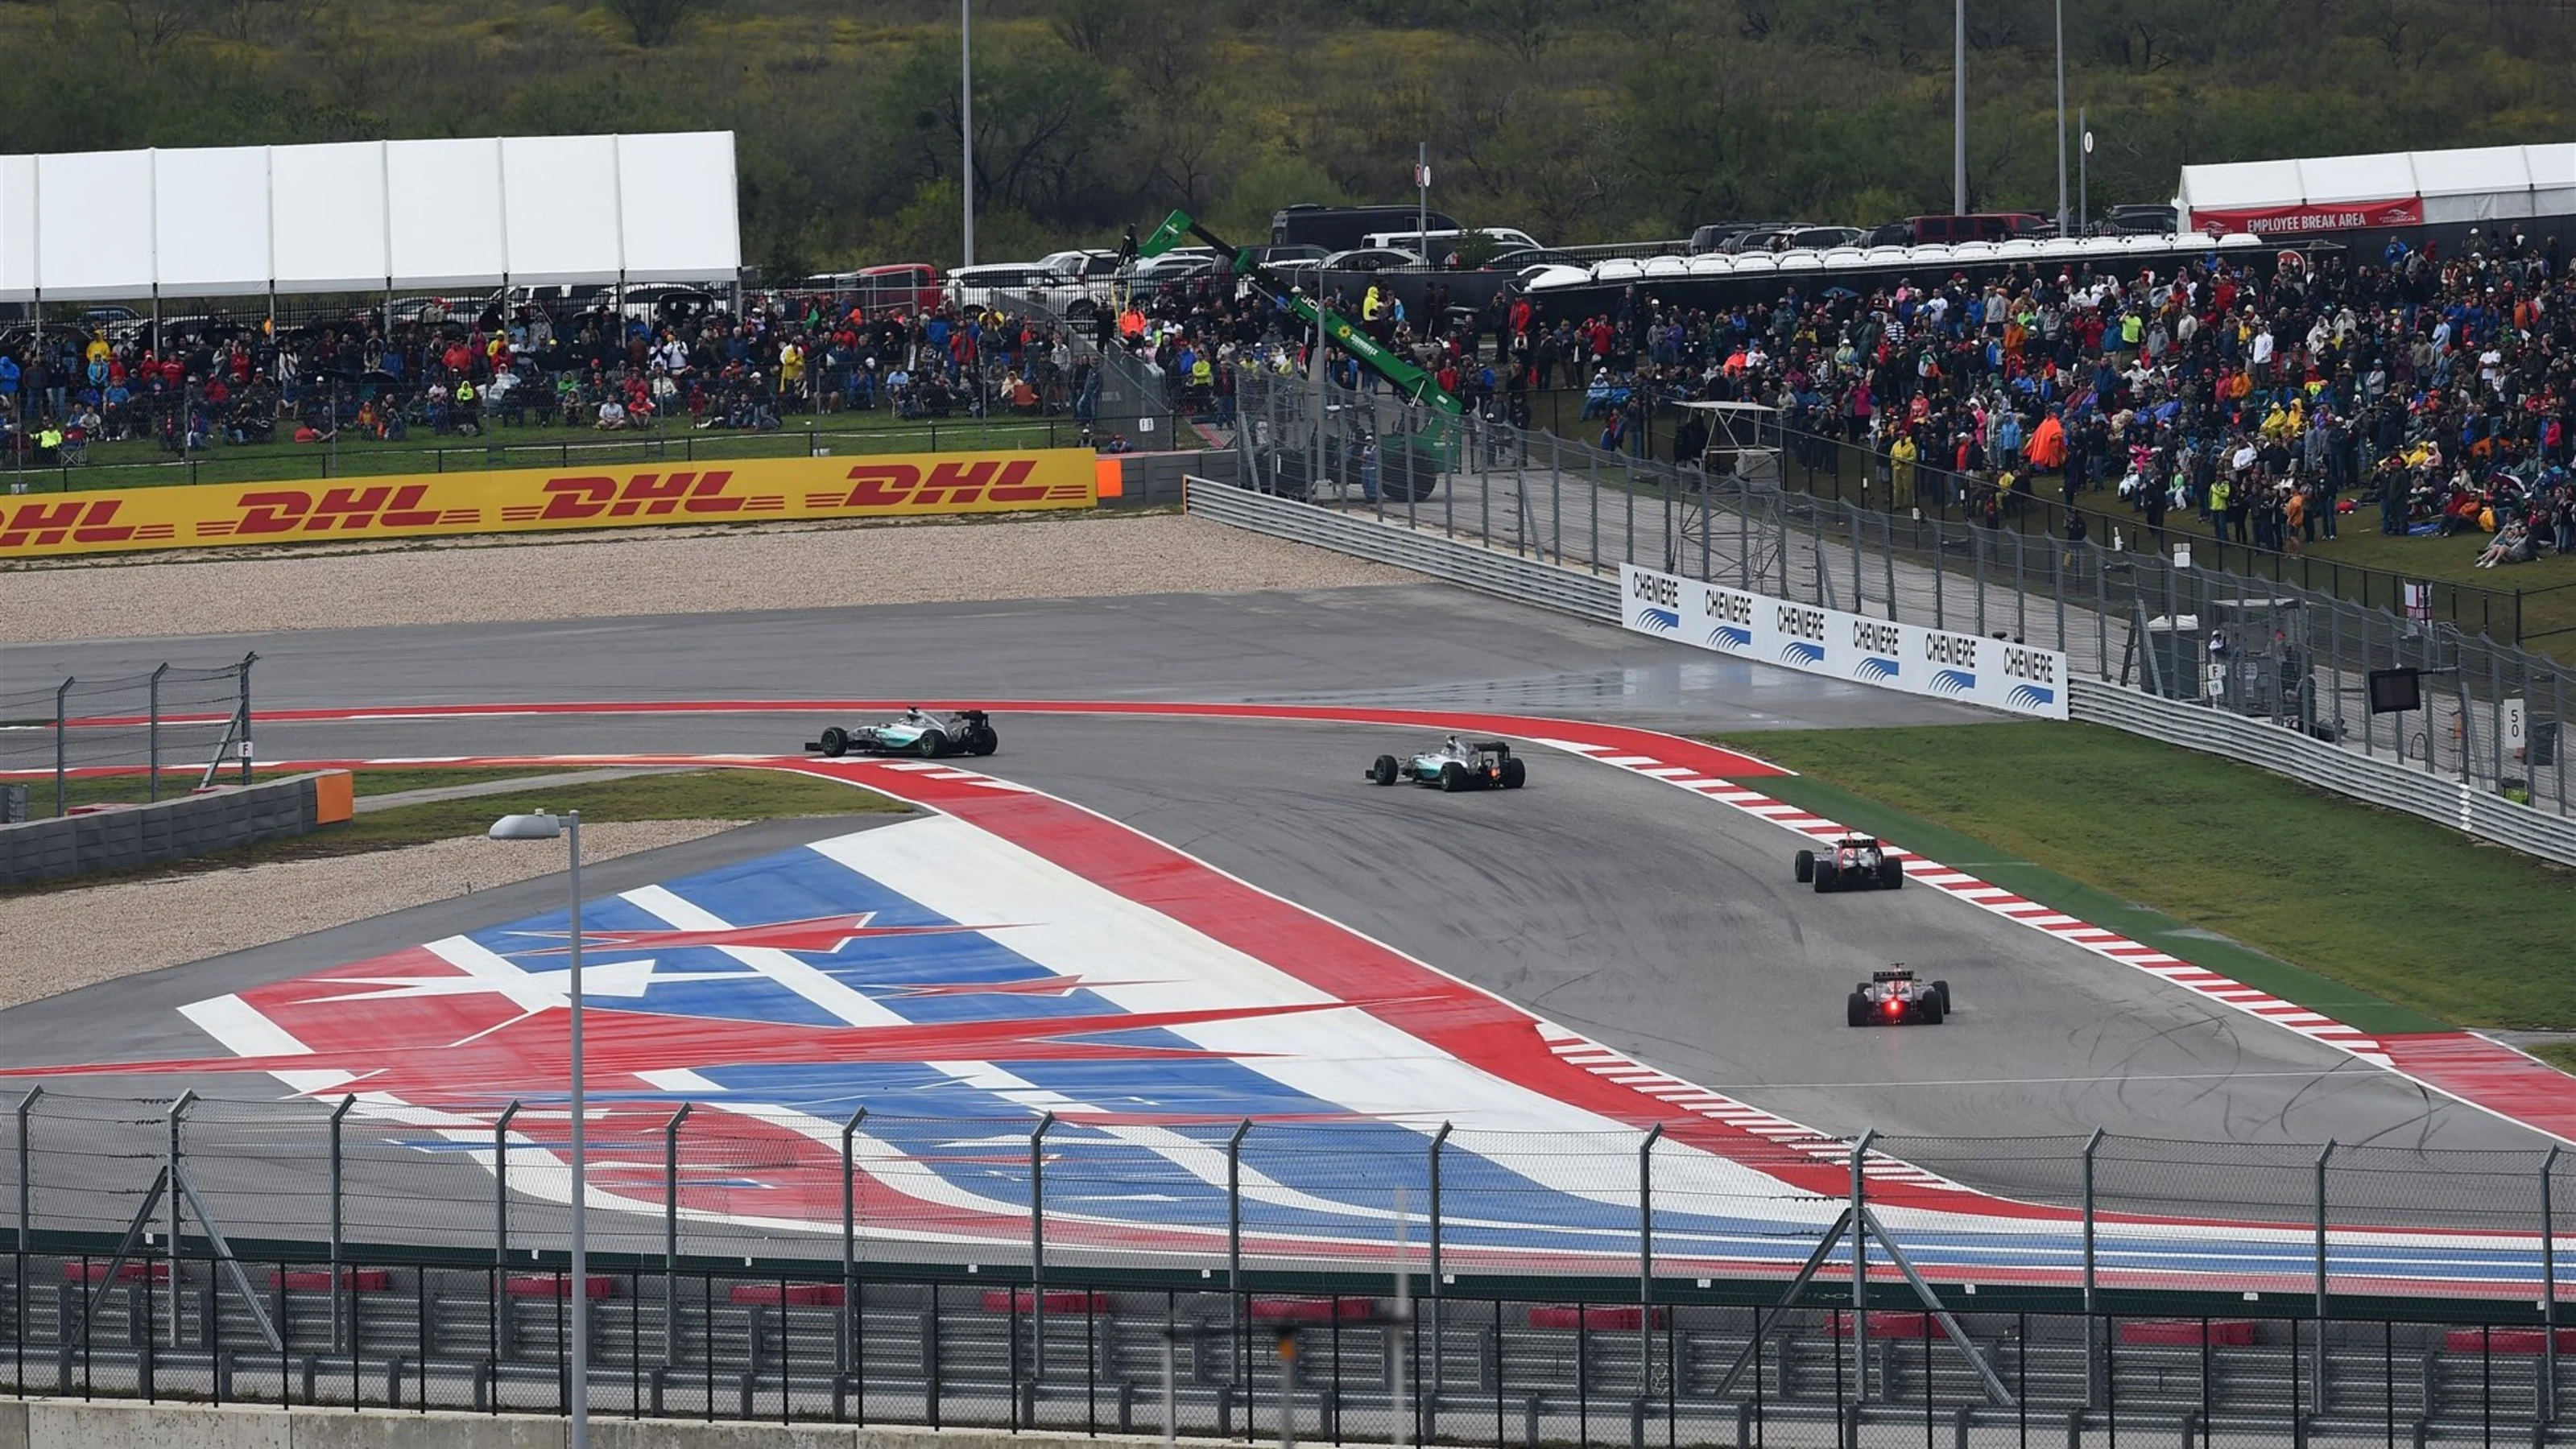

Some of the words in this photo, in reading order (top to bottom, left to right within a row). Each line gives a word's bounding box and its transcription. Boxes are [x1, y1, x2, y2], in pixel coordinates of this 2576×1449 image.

[2247, 217, 2299, 233] EMPLOYEE
[2301, 214, 2336, 229] BREAK
[2338, 213, 2367, 227] AREA
[540, 471, 746, 520] DHL
[845, 460, 1048, 508] DHL
[0, 500, 136, 547] HL
[234, 485, 441, 535] DHL
[1633, 572, 1679, 609] CHENIERE
[1705, 589, 1751, 626] CHENIERE
[1776, 605, 1825, 642] CHENIERE
[1853, 620, 1899, 656] CHENIERE
[1925, 633, 1976, 669] CHENIERE
[2003, 646, 2053, 683] CHENIERE
